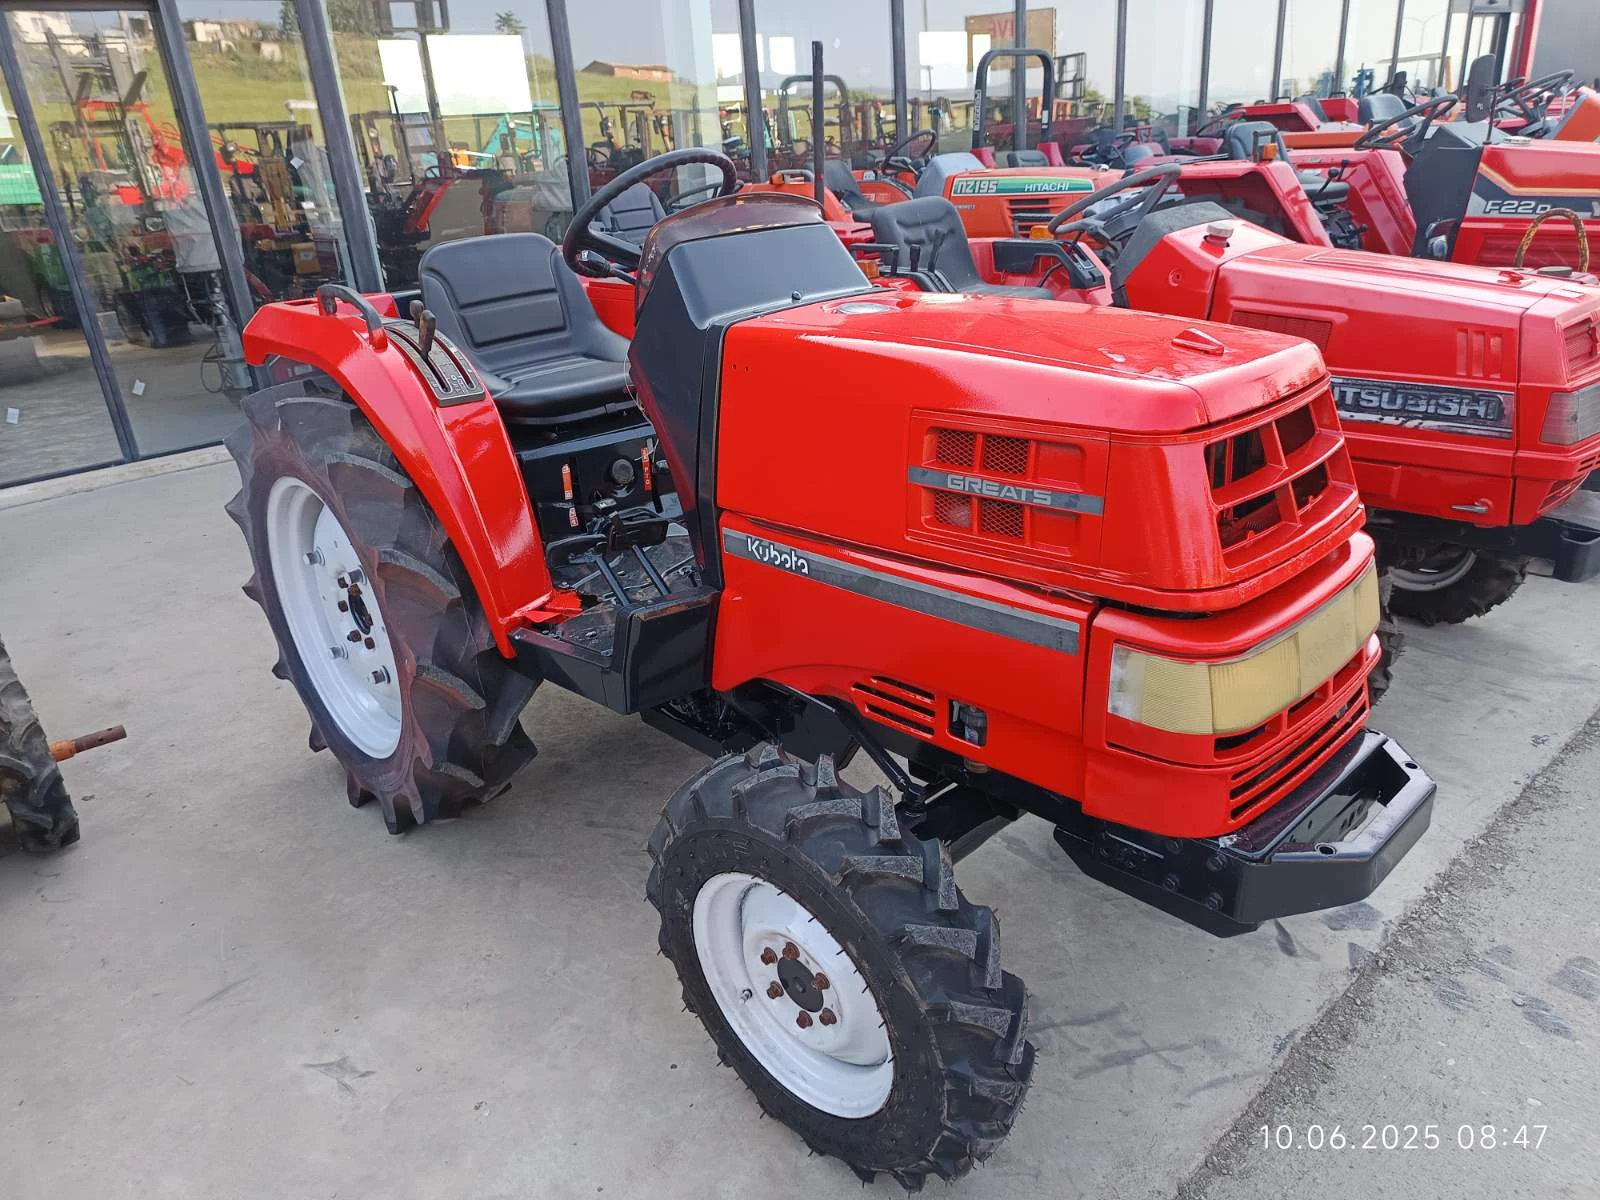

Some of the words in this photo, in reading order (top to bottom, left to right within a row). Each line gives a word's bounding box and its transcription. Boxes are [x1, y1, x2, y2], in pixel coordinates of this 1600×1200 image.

[1024, 182, 1070, 192] HITACHI
[1333, 386, 1498, 420] ITSUBISHI
[947, 474, 1051, 505] GREATS
[746, 537, 809, 575] Kubota
